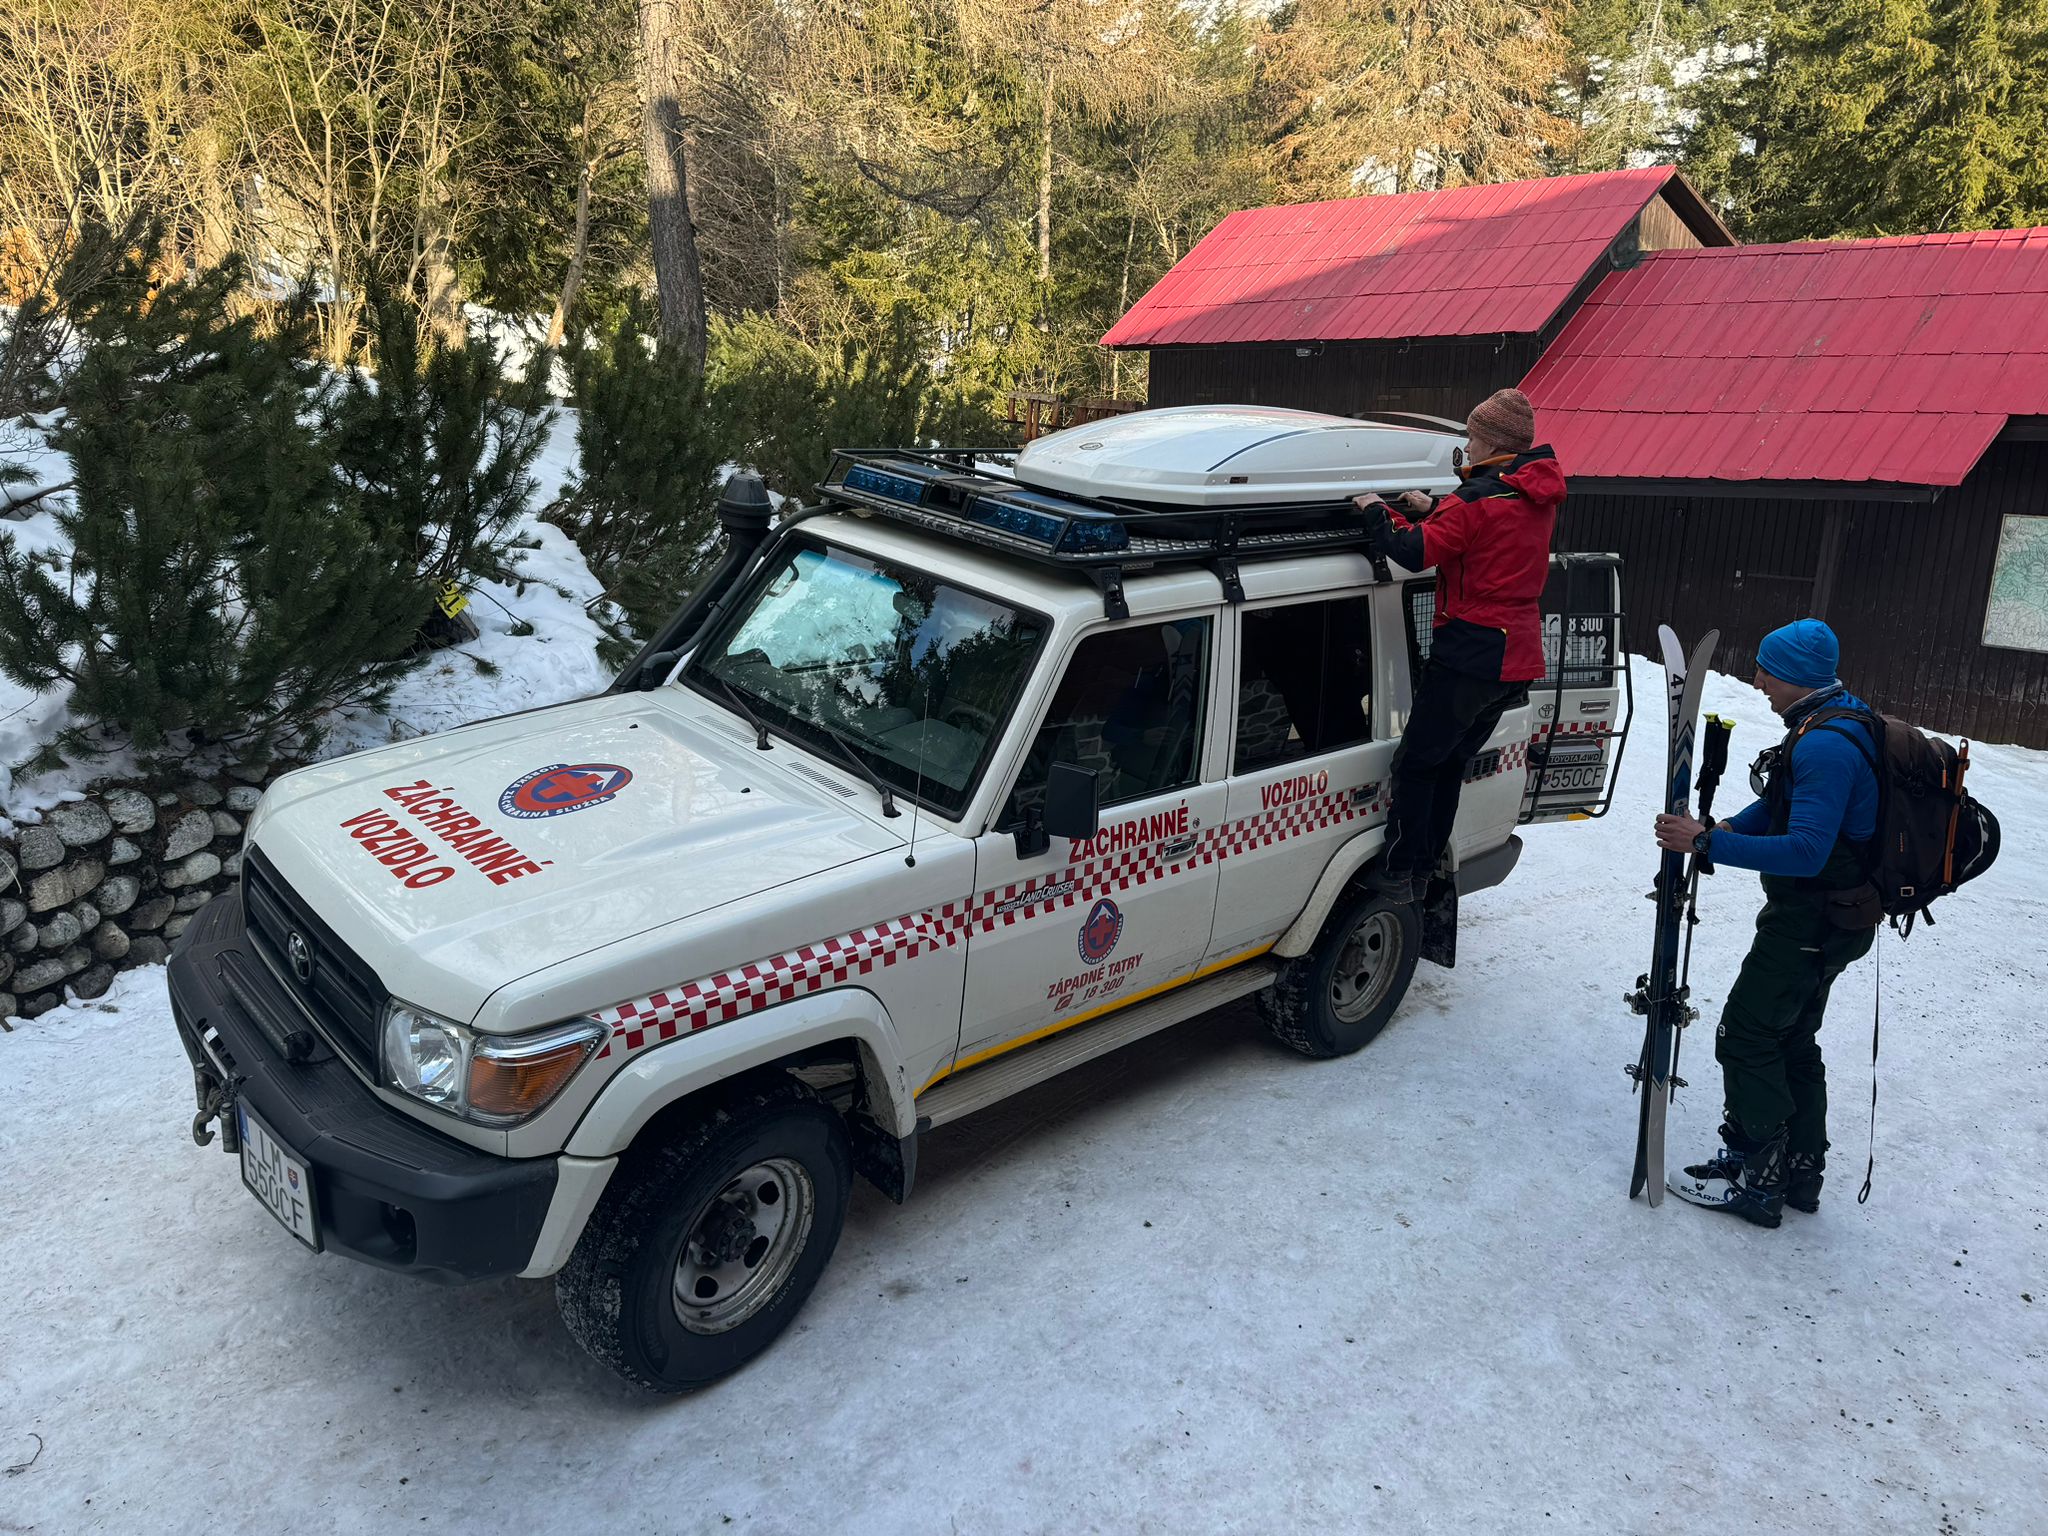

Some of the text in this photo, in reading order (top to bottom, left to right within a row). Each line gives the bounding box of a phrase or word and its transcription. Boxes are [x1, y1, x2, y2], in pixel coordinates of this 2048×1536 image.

[1580, 617, 1604, 632] 300
[1579, 635, 1607, 660] 112
[1551, 753, 1600, 763] TOYOTA 4WD
[1261, 769, 1329, 811] VOZIDLO
[1550, 766, 1605, 789] 550CF
[500, 790, 550, 818] ZÁCHRANNÁ
[555, 795, 611, 815] SLUŽBA
[339, 807, 456, 889] VOZIDLO
[382, 779, 555, 886] ZÁCHRANNÉ
[1046, 952, 1144, 1000] ZÁPADNÉ TATRY
[1082, 975, 1126, 1001] 18 300
[259, 1129, 283, 1183] LM
[247, 1148, 304, 1229] 550CF
